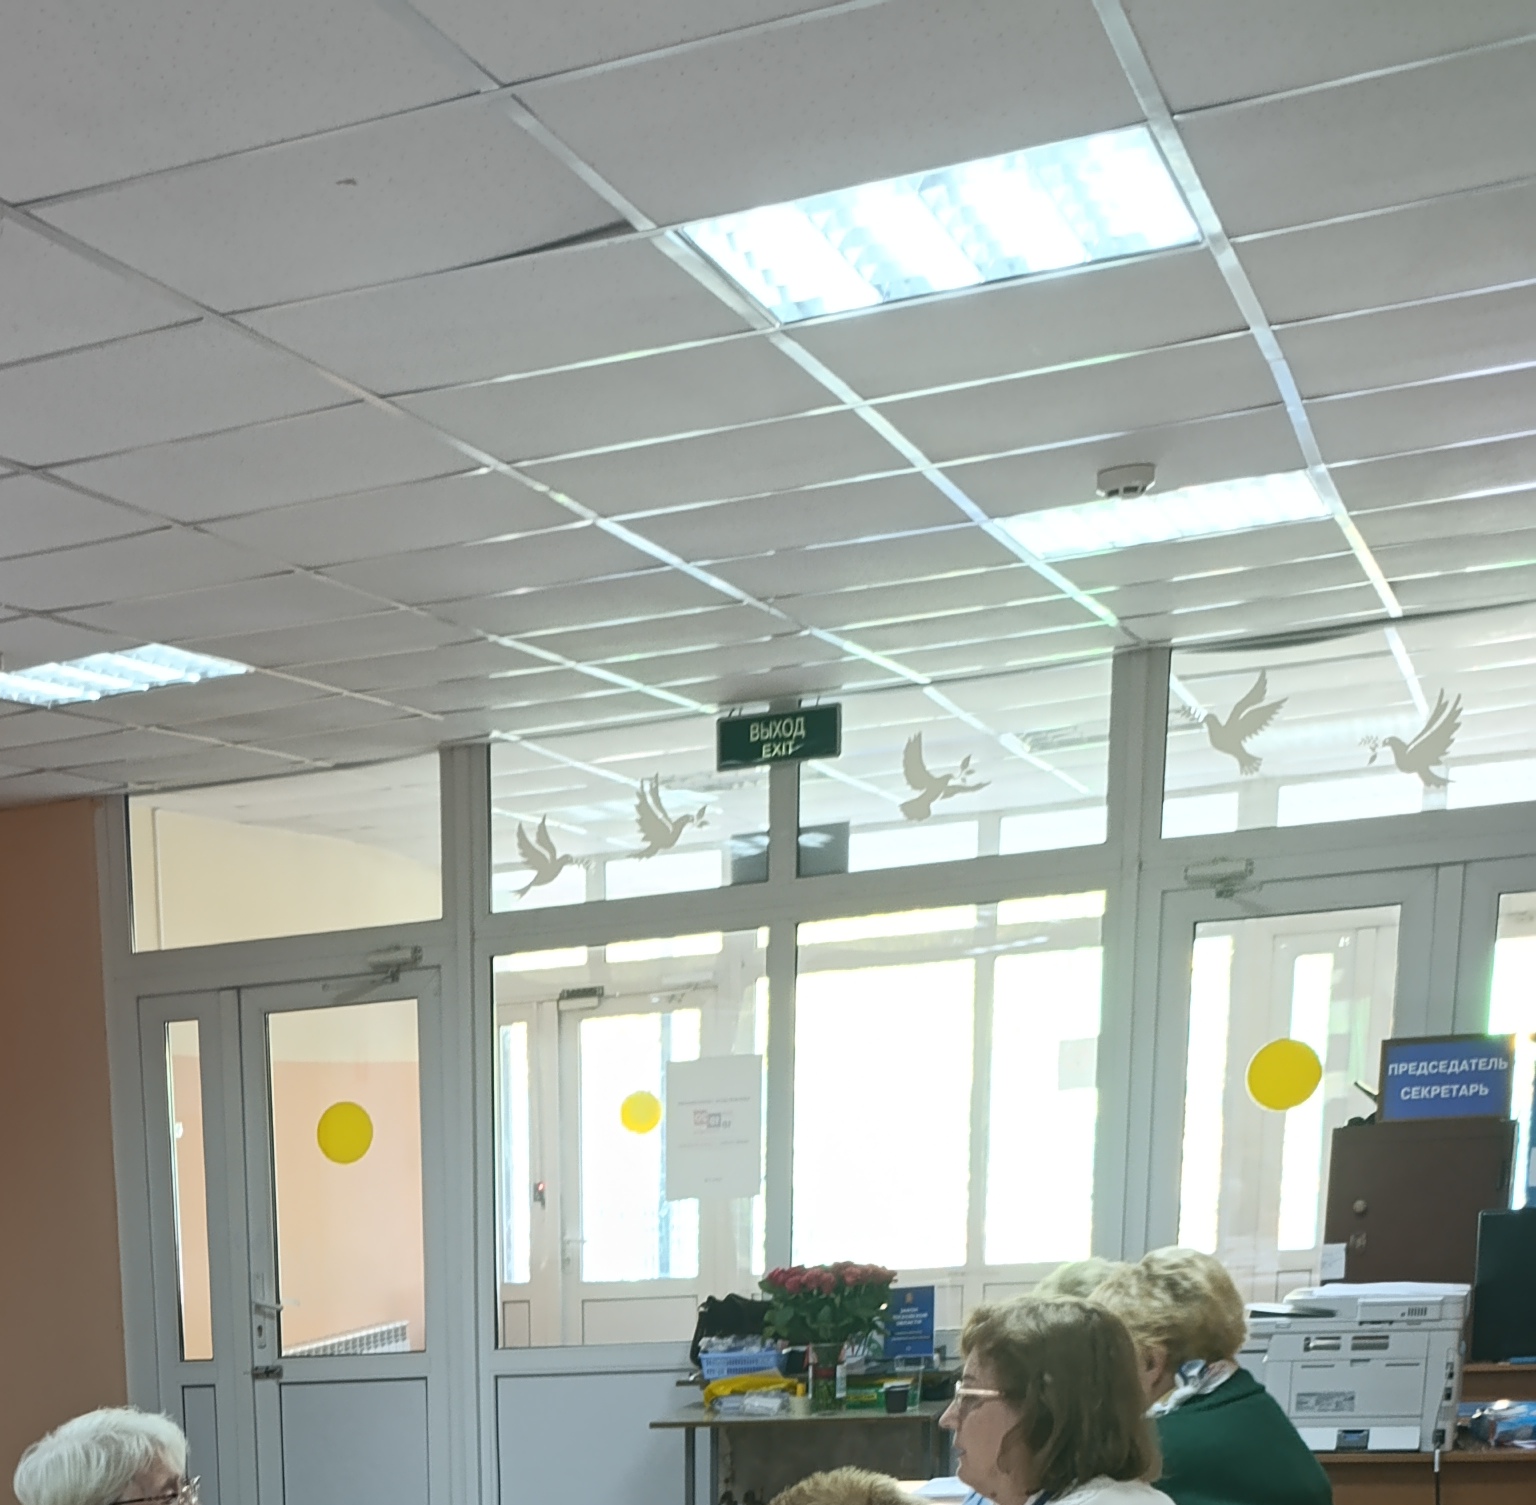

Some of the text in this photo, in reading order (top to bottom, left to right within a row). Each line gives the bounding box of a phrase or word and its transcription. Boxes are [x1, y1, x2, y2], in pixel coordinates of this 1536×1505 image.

[749, 716, 806, 743] ВЫХОД
[762, 741, 795, 758] EXIT
[1388, 1057, 1509, 1077] ПРЕДСЕДАТЕЛЬ
[1400, 1083, 1490, 1100] СЕКРЕТАРЬ
